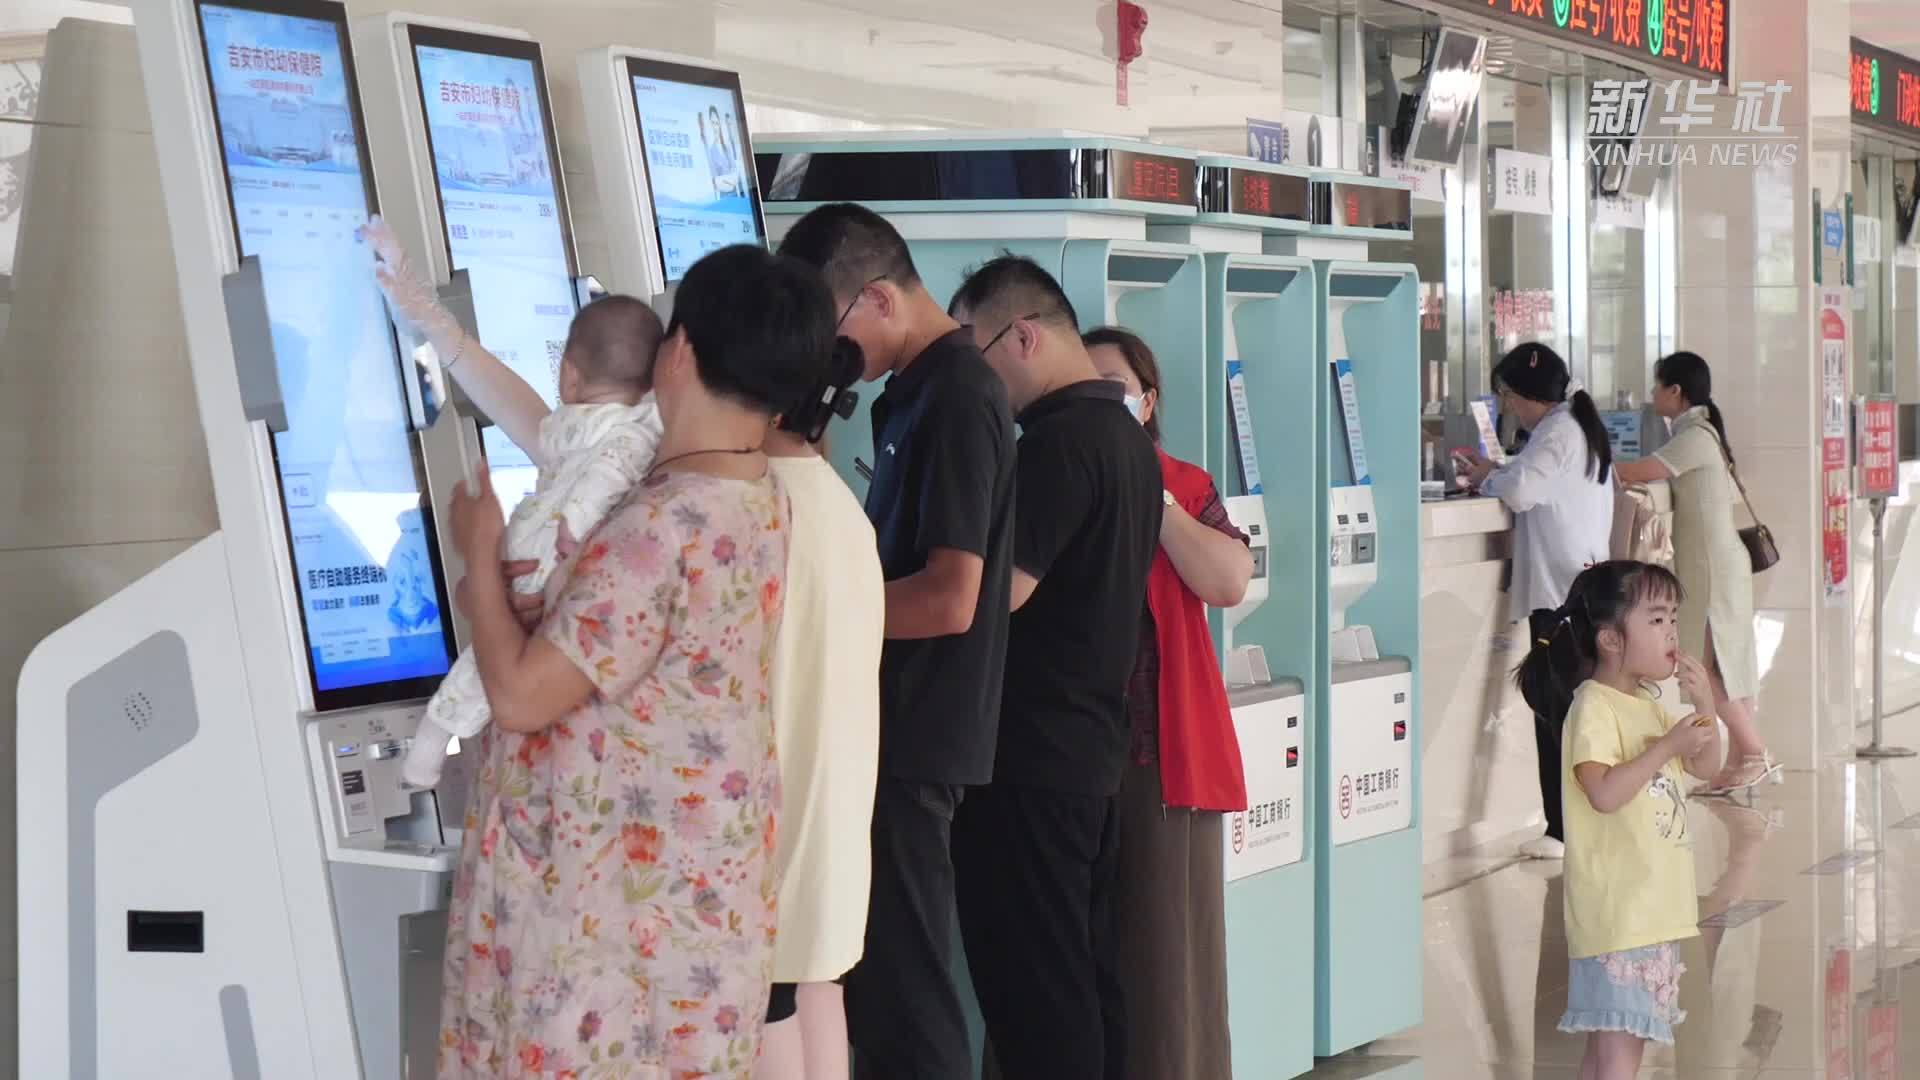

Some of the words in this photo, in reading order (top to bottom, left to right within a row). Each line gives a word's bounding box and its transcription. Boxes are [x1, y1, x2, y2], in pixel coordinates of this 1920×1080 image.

[227, 44, 323, 77] 吉安市妇幼保健院
[439, 79, 521, 112] 吉安市妇幼保健院
[308, 565, 388, 590] 医疗自助服务终端机
[1355, 768, 1399, 798] 中国工商银行
[1248, 798, 1291, 831] 中国工商银行
